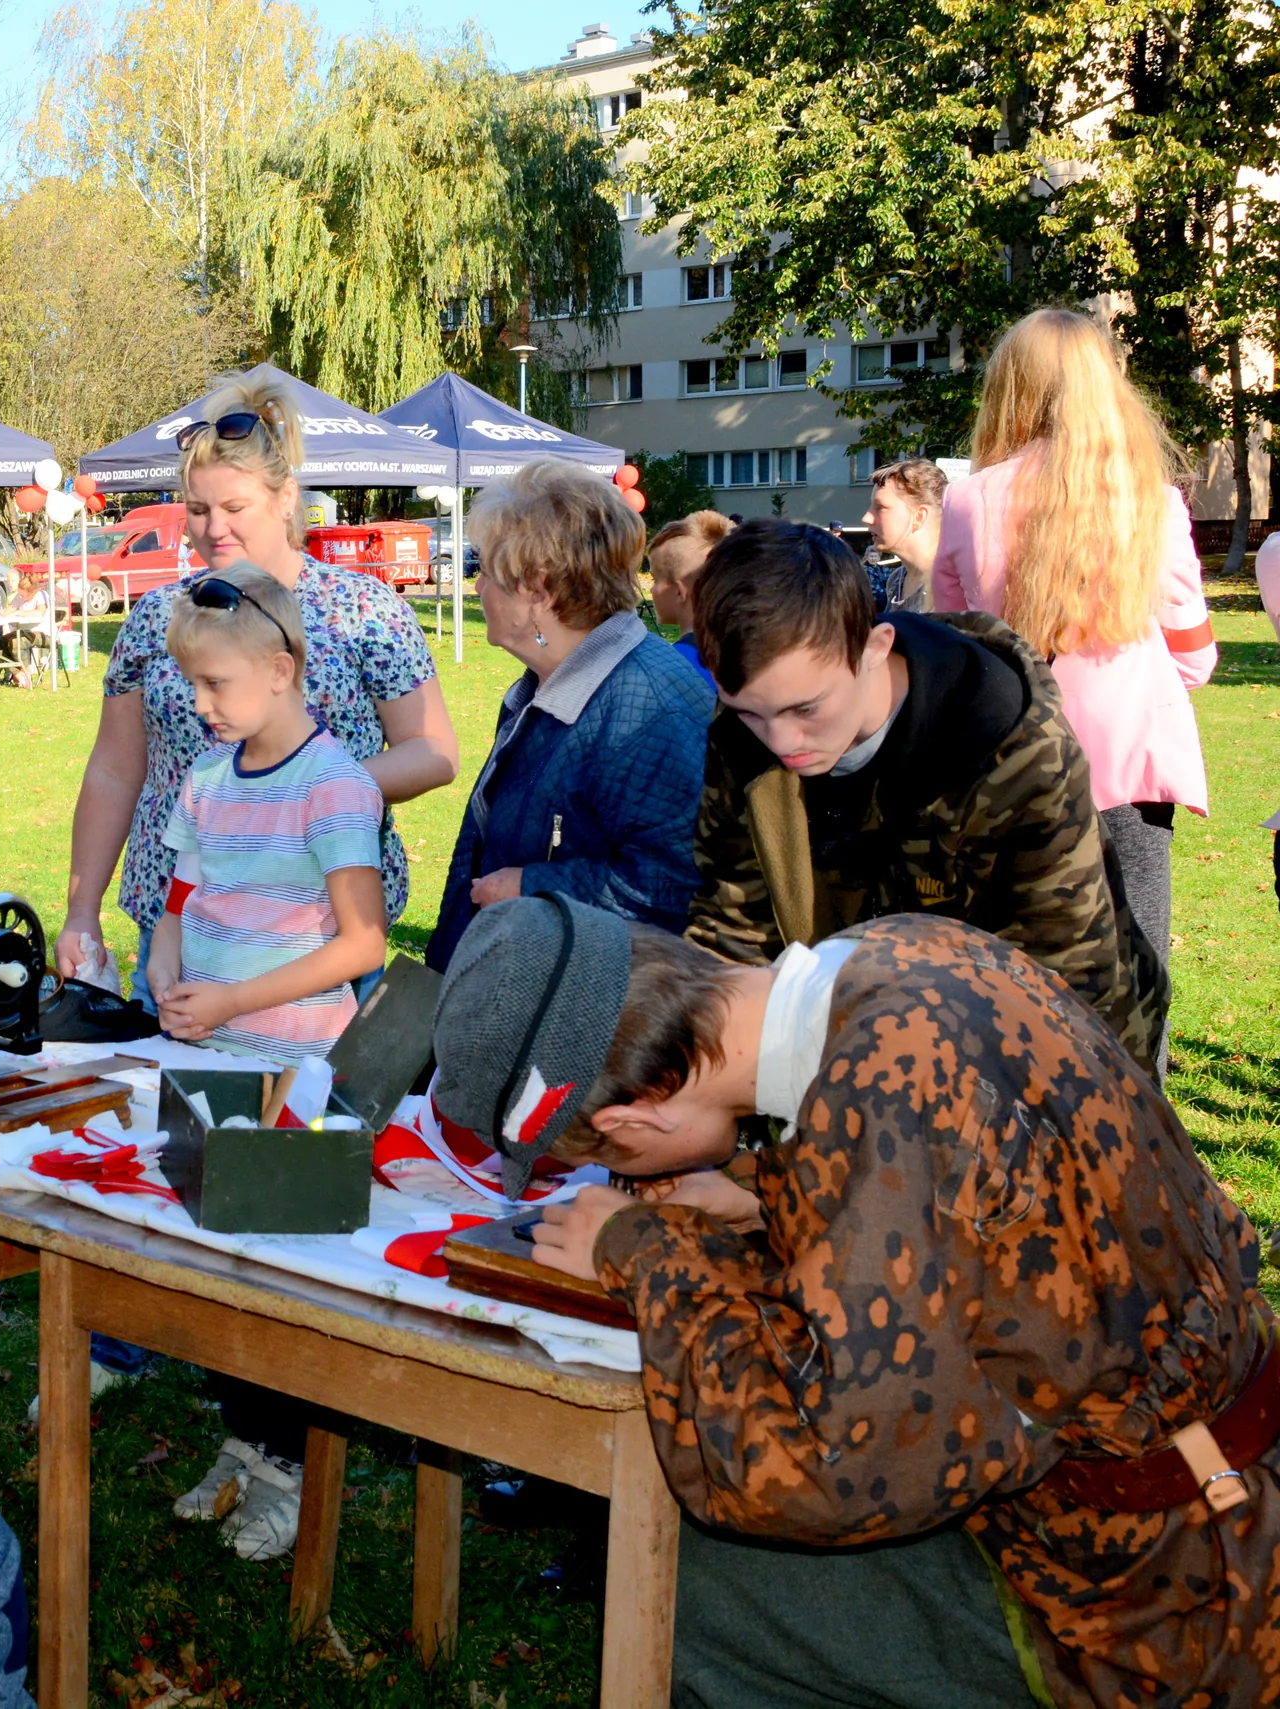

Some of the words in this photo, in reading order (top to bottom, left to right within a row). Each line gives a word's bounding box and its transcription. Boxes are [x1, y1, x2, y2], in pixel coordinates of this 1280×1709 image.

[112, 468, 149, 480] DZIELNICY
[149, 467, 177, 478] OCHOT
[301, 462, 343, 473] DZIELNICY
[344, 462, 379, 473] OCHOTA
[402, 463, 447, 474] WARSZAWY
[469, 465, 495, 477] URZĄD
[915, 877, 945, 897] NIKE
